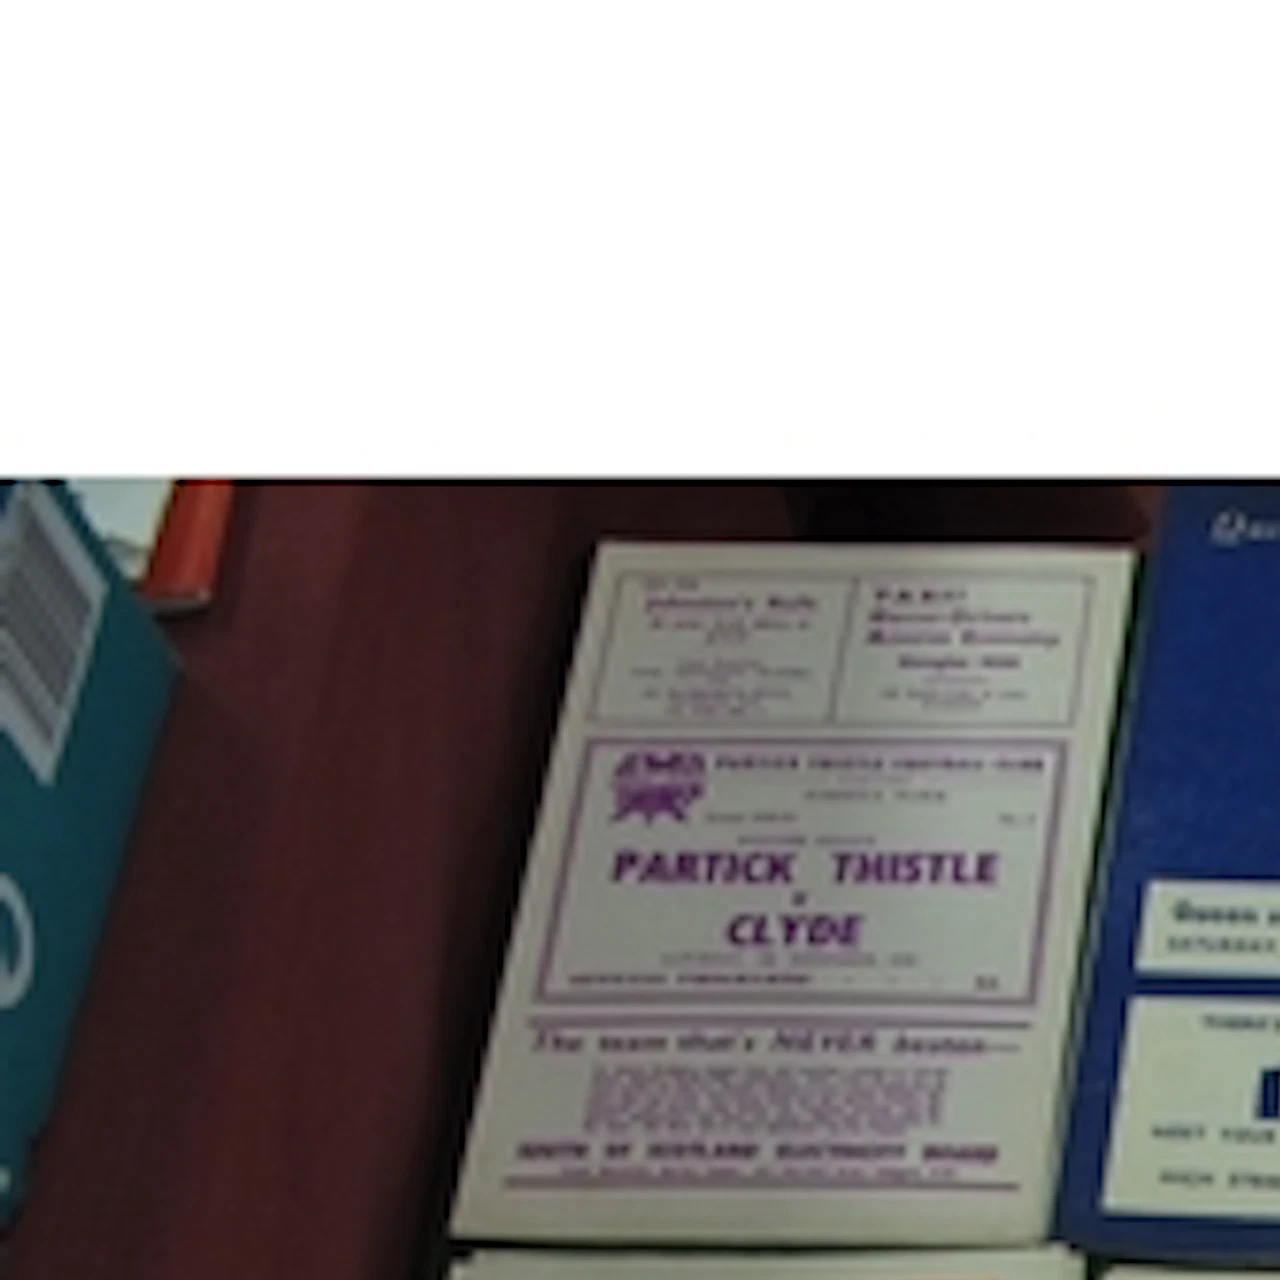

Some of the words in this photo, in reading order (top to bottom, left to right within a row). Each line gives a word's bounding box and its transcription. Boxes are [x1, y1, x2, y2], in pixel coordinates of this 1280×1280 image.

[609, 851, 797, 885] PARTICK
[832, 851, 999, 885] THISTLE
[1169, 898, 1259, 928] Queen
[725, 914, 866, 948] CLYDE
